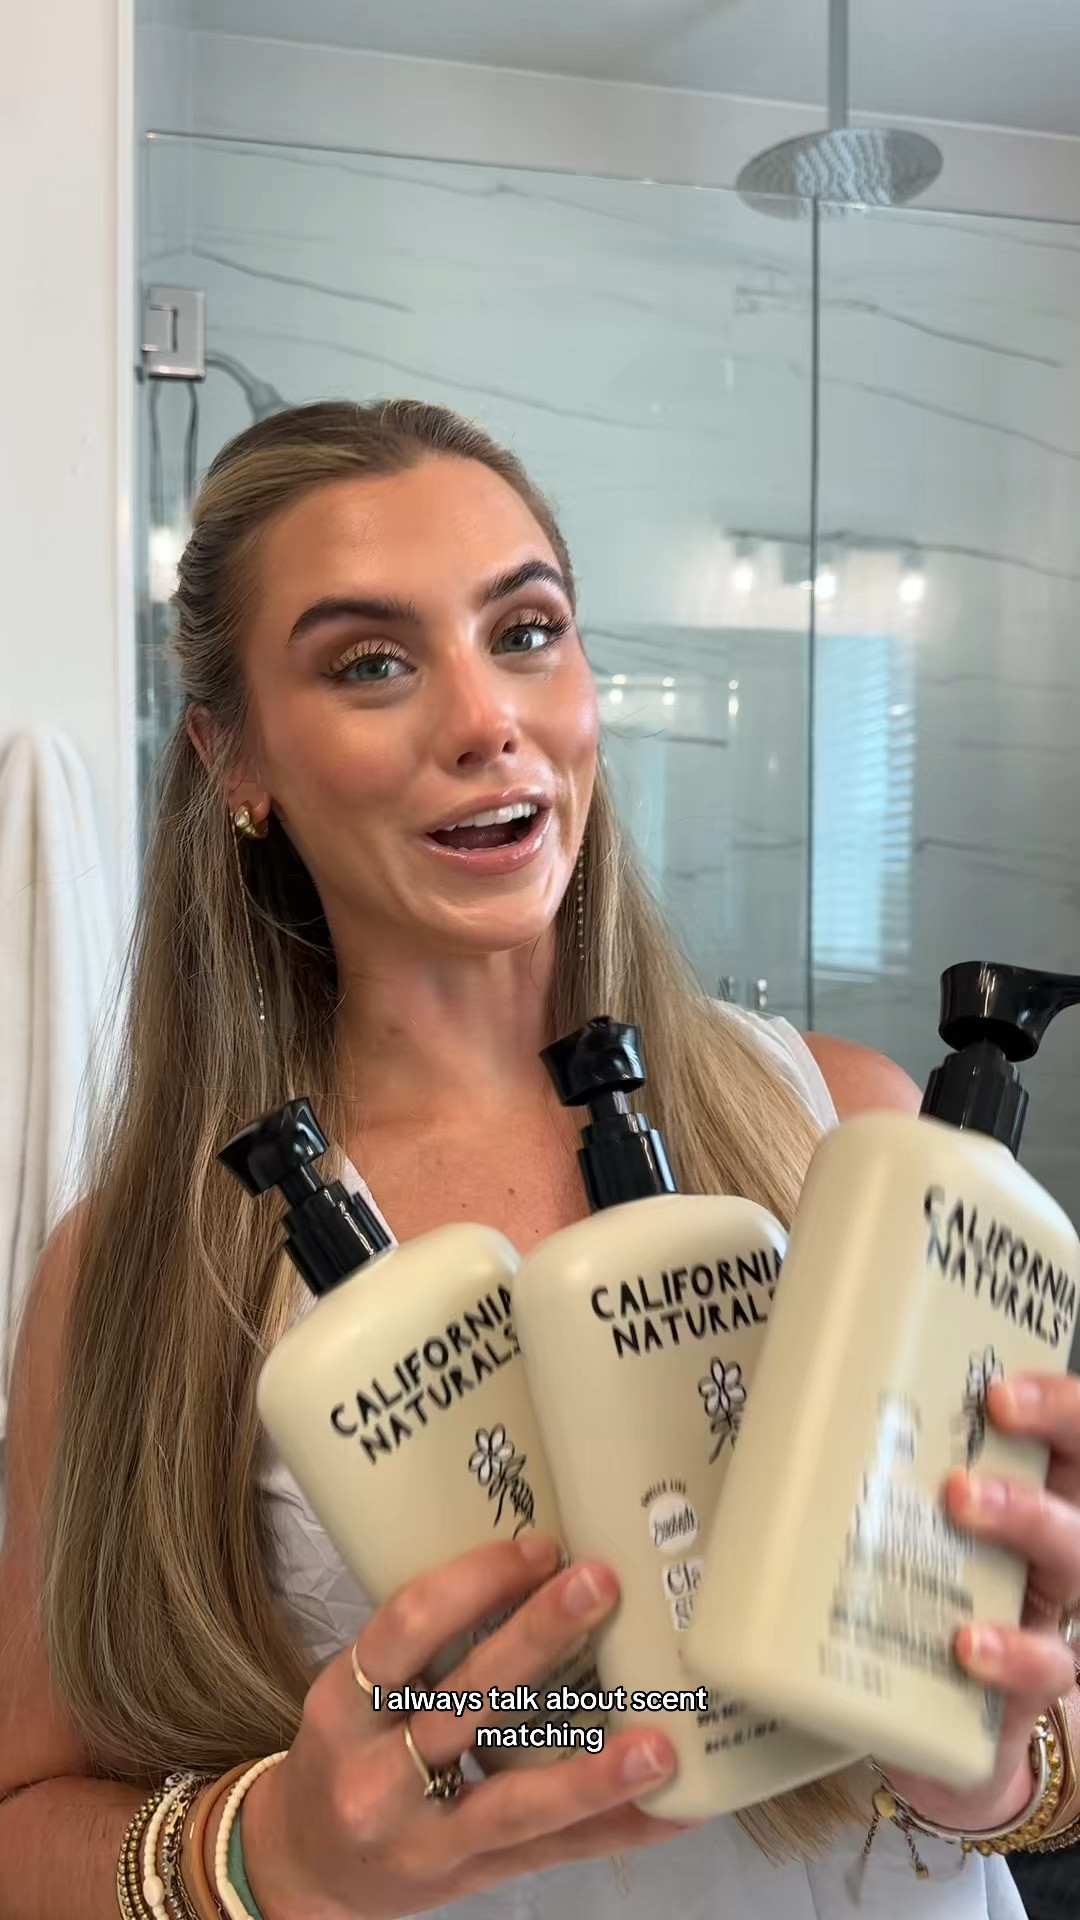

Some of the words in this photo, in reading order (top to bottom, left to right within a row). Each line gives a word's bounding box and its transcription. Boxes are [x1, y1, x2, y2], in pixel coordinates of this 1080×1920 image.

[612, 1287, 775, 1359] NATURAL
[924, 1184, 1076, 1323] CALIFORNIA
[330, 1284, 512, 1438] CALIFORNIA
